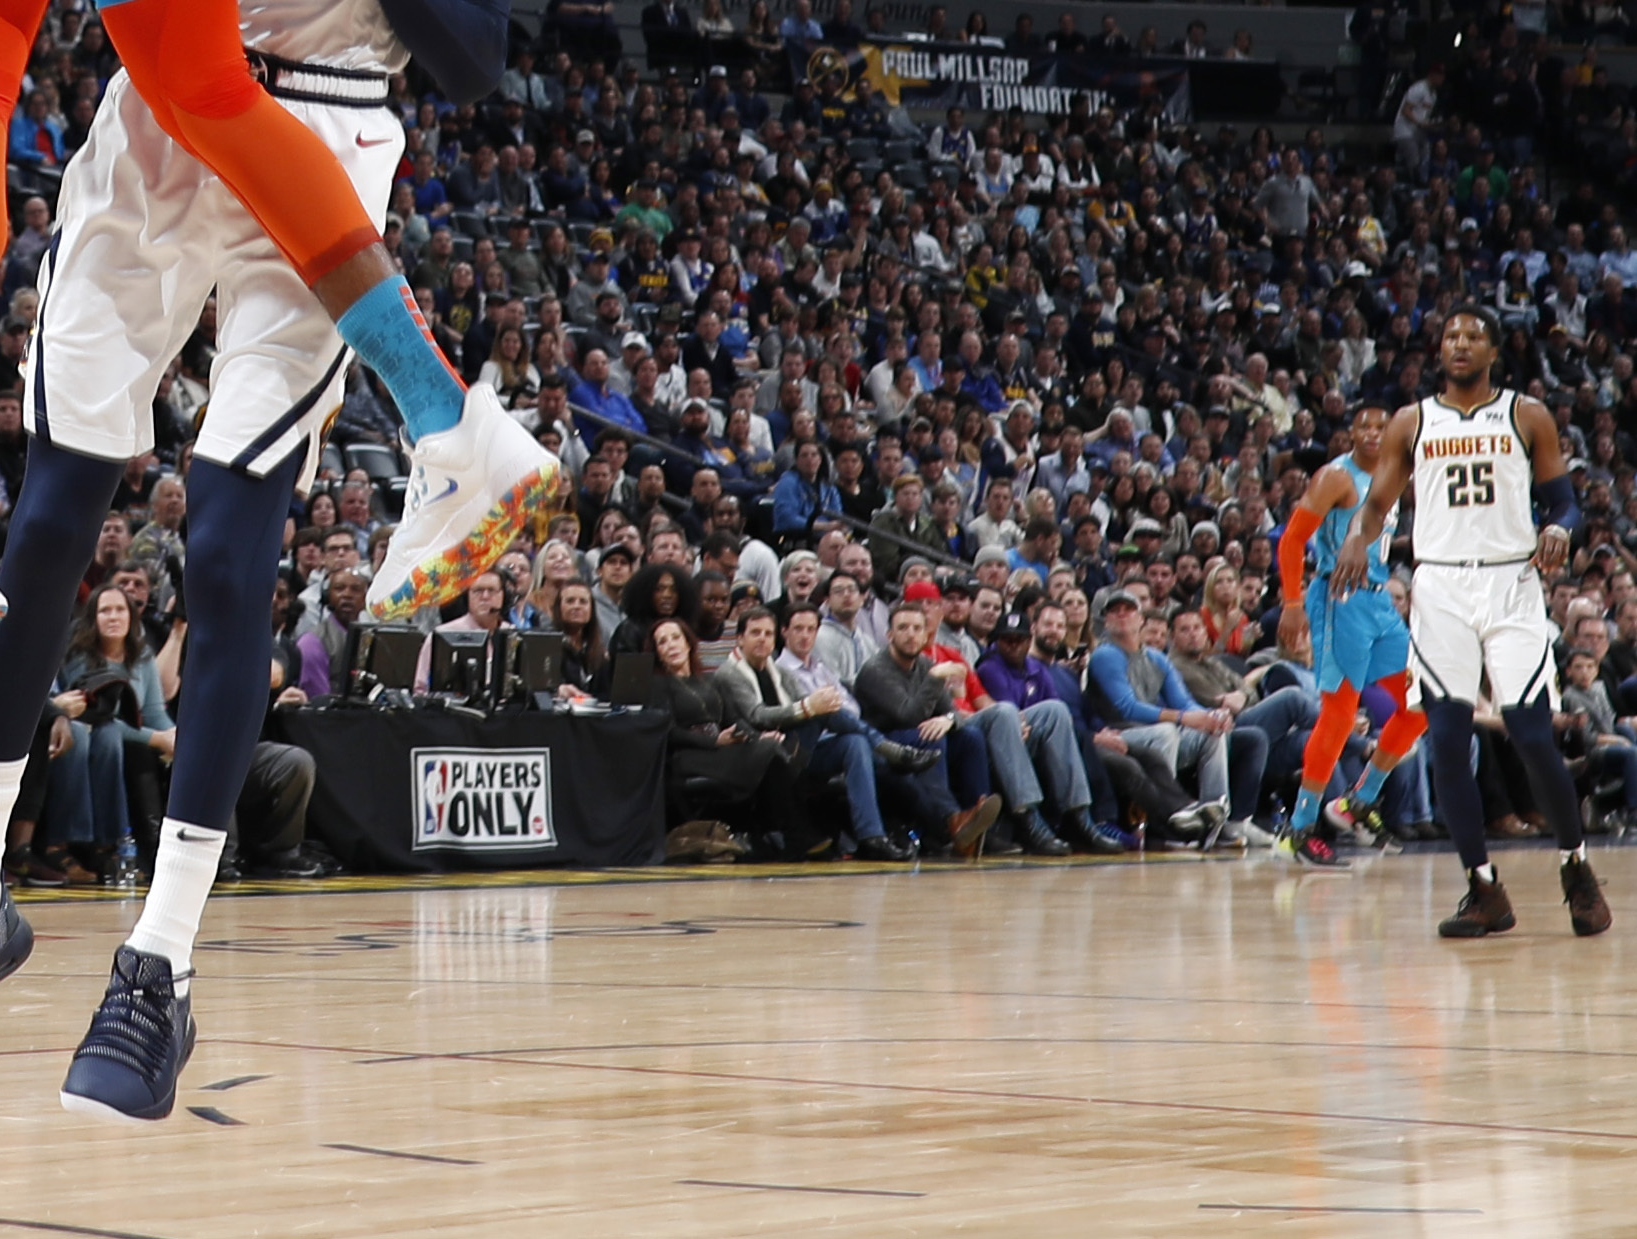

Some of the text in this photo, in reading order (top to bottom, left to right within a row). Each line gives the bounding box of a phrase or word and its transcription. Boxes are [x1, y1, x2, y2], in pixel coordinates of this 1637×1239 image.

[882, 49, 1029, 84] PAUL MILLSAP
[1423, 434, 1512, 461] NUGGETS
[1446, 462, 1496, 509] 25
[451, 761, 542, 789] PLAYERS
[447, 791, 535, 837] ONLY
